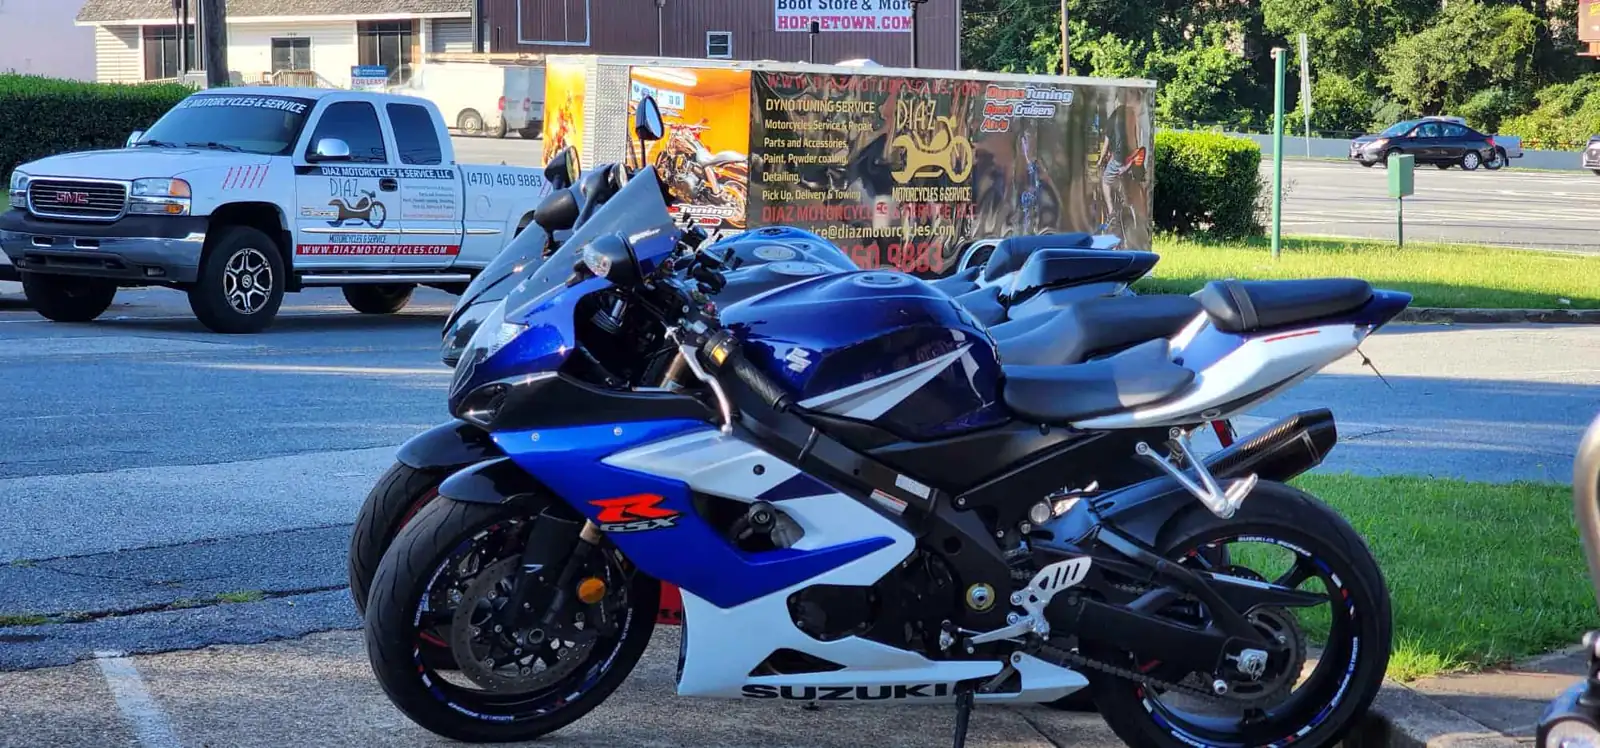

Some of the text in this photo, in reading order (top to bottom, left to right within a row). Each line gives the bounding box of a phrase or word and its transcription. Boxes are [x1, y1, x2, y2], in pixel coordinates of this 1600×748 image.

[777, 0, 812, 10] Boot
[818, 0, 858, 10] Store
[861, 0, 872, 10] &
[262, 99, 308, 114] SERVICE
[765, 98, 876, 113] DYNO TUNING SERVICE
[1015, 103, 1055, 115] Cruisers
[897, 99, 937, 130] DIAZ
[764, 119, 811, 132] Motorcycles
[813, 120, 843, 131] Service
[763, 137, 785, 148] Parts
[787, 138, 801, 148] and
[788, 153, 817, 164] Powder
[322, 167, 340, 176] DIAZ
[342, 167, 397, 177] MOTORCYCLES
[467, 172, 542, 187] (470) 460 9883
[330, 178, 358, 197] DIAZ
[892, 186, 938, 201] MOTORCYCLES
[945, 187, 971, 201] SERVICE
[55, 191, 90, 204] GMC
[762, 190, 779, 200] Pick
[795, 190, 826, 202] Delivery
[835, 190, 861, 201] Towing
[762, 205, 794, 222] DIAZ
[797, 204, 876, 221] MOTORCYCL
[302, 245, 448, 254] WWW.DIAZMOTORCYCLES.COM
[588, 493, 680, 522] R
[600, 516, 680, 533] GSX
[741, 683, 948, 700] SUZUKI
